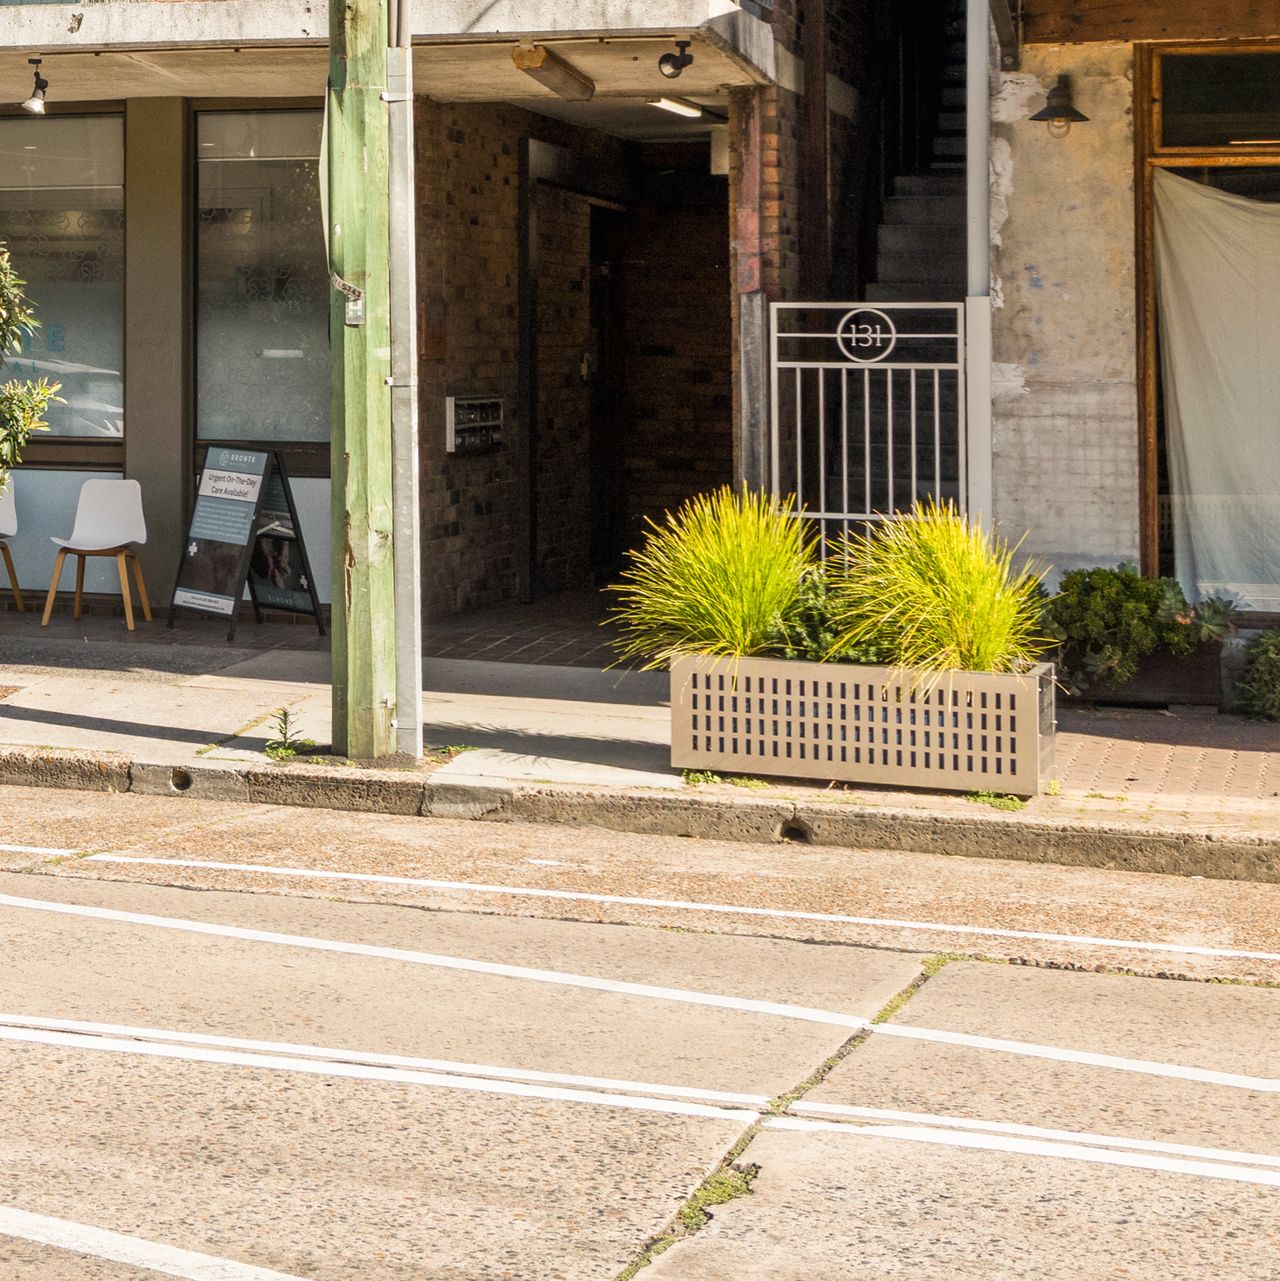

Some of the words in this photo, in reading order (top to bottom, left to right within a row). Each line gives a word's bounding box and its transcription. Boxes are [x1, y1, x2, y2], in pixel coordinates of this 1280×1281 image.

[850, 324, 882, 347] 131
[230, 453, 256, 463] BRONTE
[208, 473, 227, 483] Urgent
[227, 475, 257, 488] On-The-Day
[211, 486, 223, 494] Care
